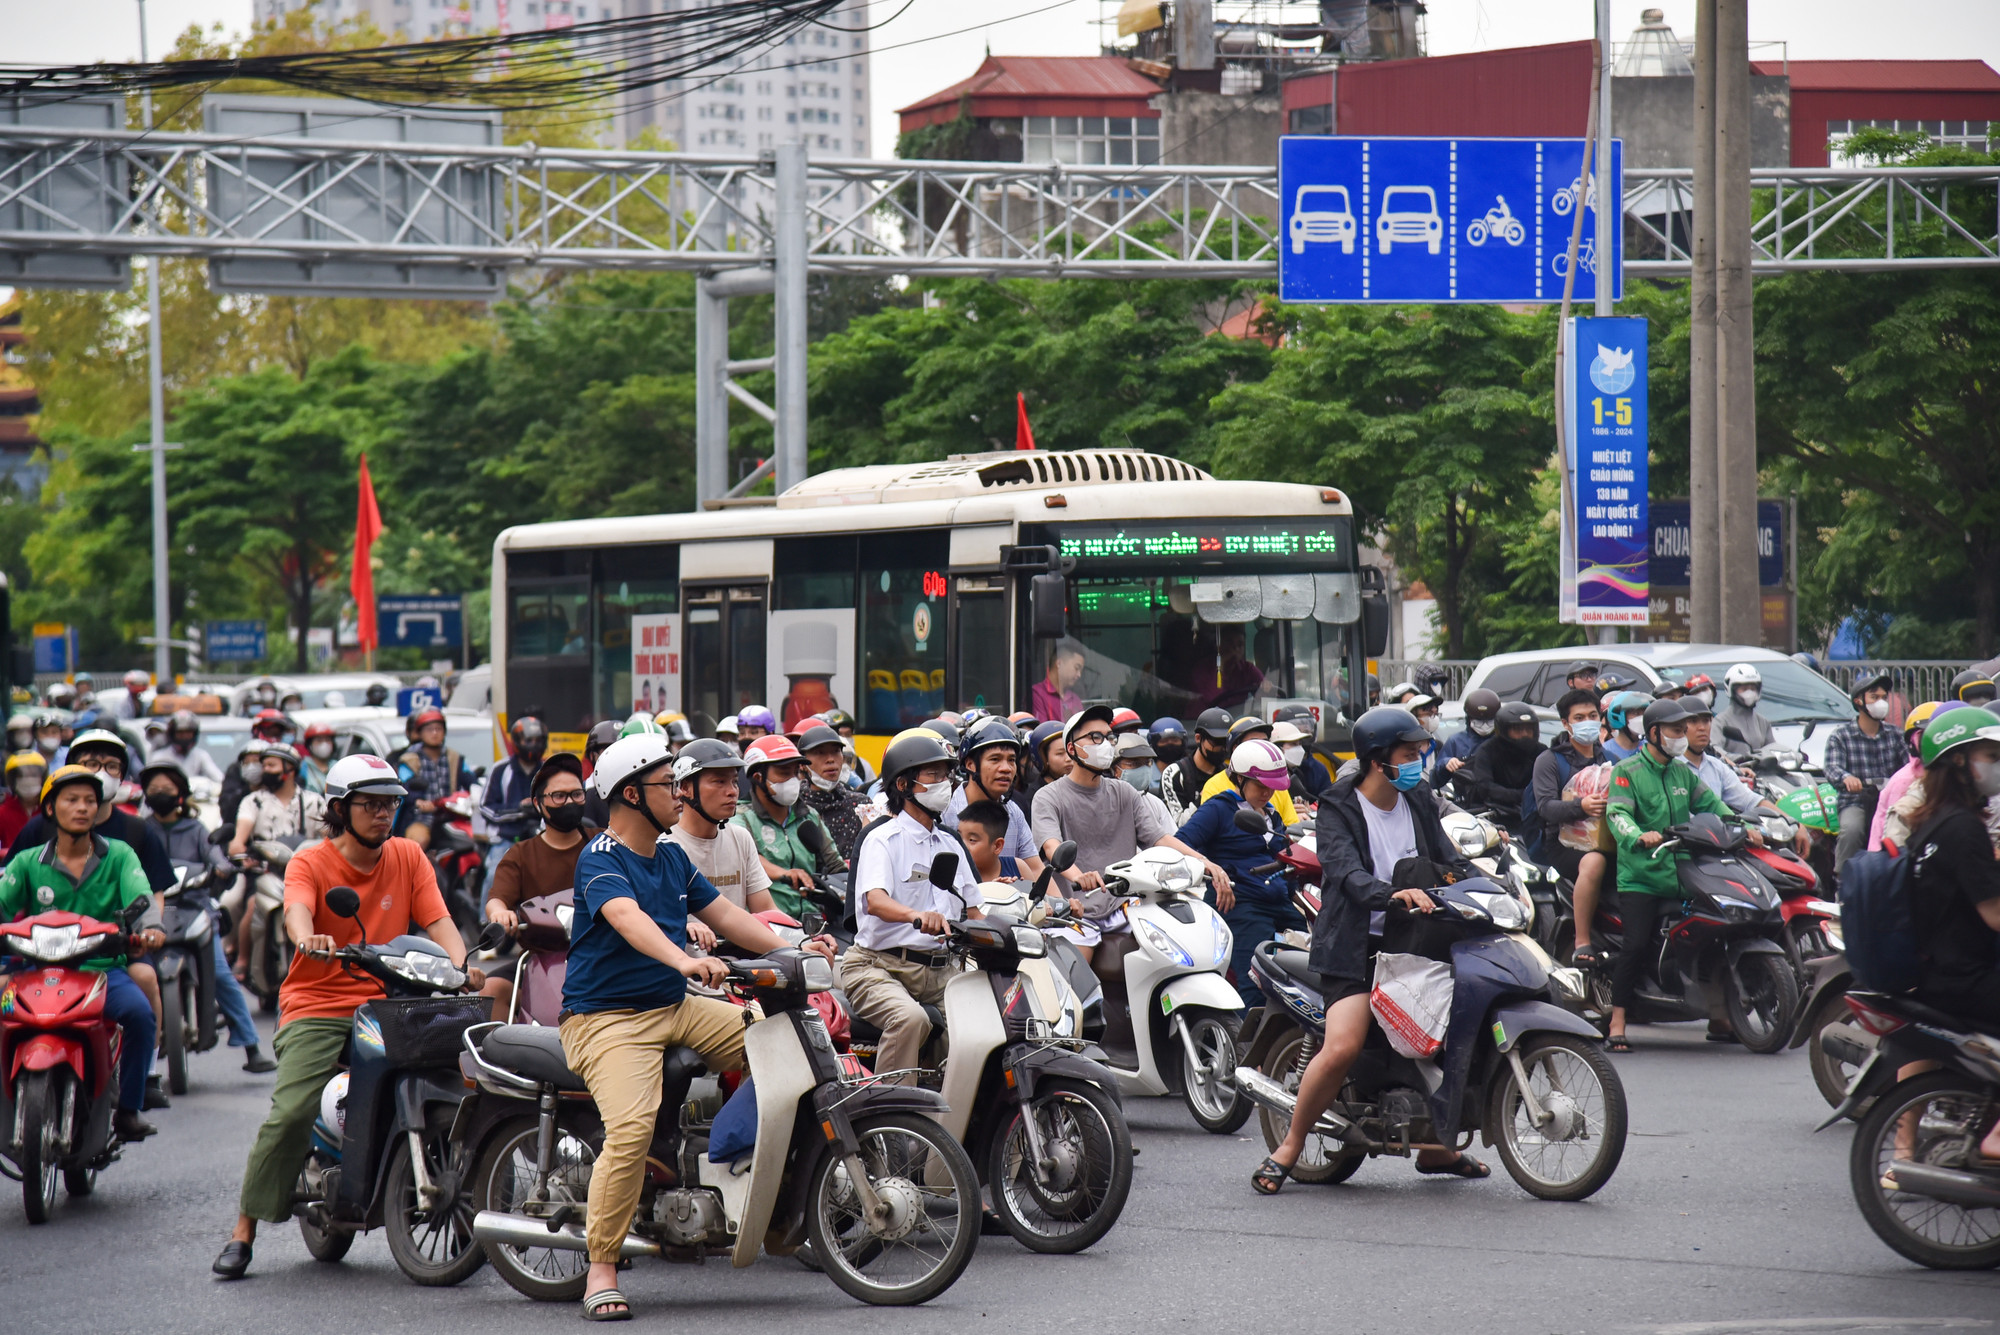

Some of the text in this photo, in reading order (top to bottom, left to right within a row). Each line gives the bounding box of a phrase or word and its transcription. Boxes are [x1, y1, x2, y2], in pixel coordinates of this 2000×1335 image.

[1591, 397, 1632, 425] 1-5
[1615, 427, 1633, 436] 2024
[1592, 448, 1632, 466] NHIỆT LIỆT
[1590, 467, 1635, 483] CHÀO MỪNG
[1596, 486, 1629, 500] 138 NĂM
[1586, 503, 1640, 520] NGÀY QUỐC TẾ
[1592, 525, 1607, 538] LAO
[1607, 523, 1628, 539] ĐỘNG
[1654, 519, 1691, 557] CHÙA
[923, 570, 947, 597] 60B
[1581, 611, 1602, 623] QUẬN
[1604, 611, 1630, 622] HOÀNG
[1631, 612, 1647, 622] MAI
[1932, 724, 1967, 745] Grab
